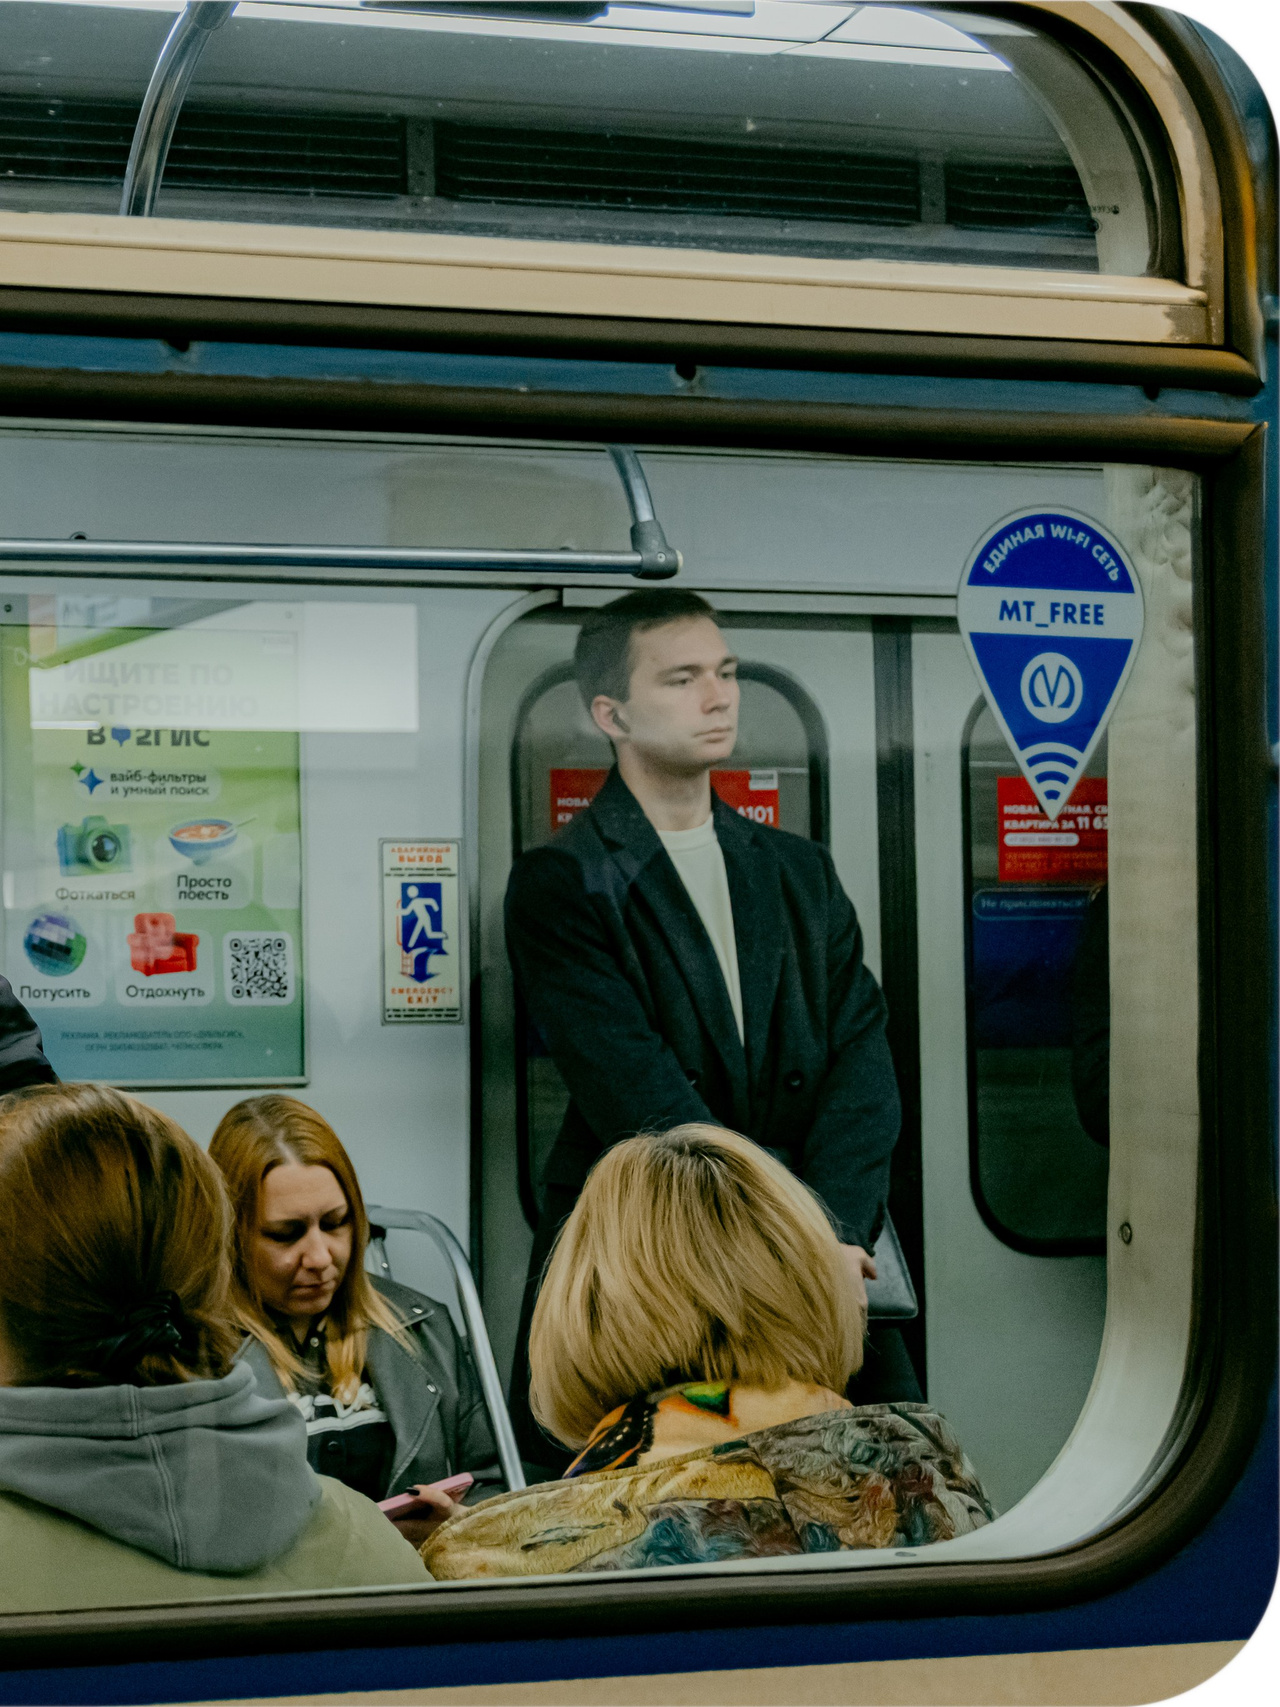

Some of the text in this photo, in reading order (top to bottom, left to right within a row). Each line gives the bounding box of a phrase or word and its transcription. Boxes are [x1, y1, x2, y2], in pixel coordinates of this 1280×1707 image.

[1050, 523, 1091, 549] WI-FI
[982, 523, 1046, 575] ЕДИНАЯ
[1091, 544, 1121, 582] СЕТЬ
[998, 600, 1105, 628] MT_FREE
[63, 661, 234, 687] ИЩИТЕ ПО
[38, 692, 260, 718] НАСТРОЕНИЮ
[110, 770, 207, 785] вайб-фильтры
[123, 784, 167, 797] умный
[170, 785, 210, 796] поиск
[557, 797, 591, 807] НОВА
[1076, 816, 1090, 830] 11
[391, 846, 451, 854] АВАРИЙНЫЙ
[398, 854, 444, 864] ВЫХОД
[177, 874, 232, 893] Просто
[55, 887, 136, 901] Фоткаться
[178, 889, 229, 901] поесть
[20, 984, 206, 1002] Потусить Отдохнуть
[391, 986, 453, 995] EMERGENCY
[407, 996, 439, 1005] EXIT
